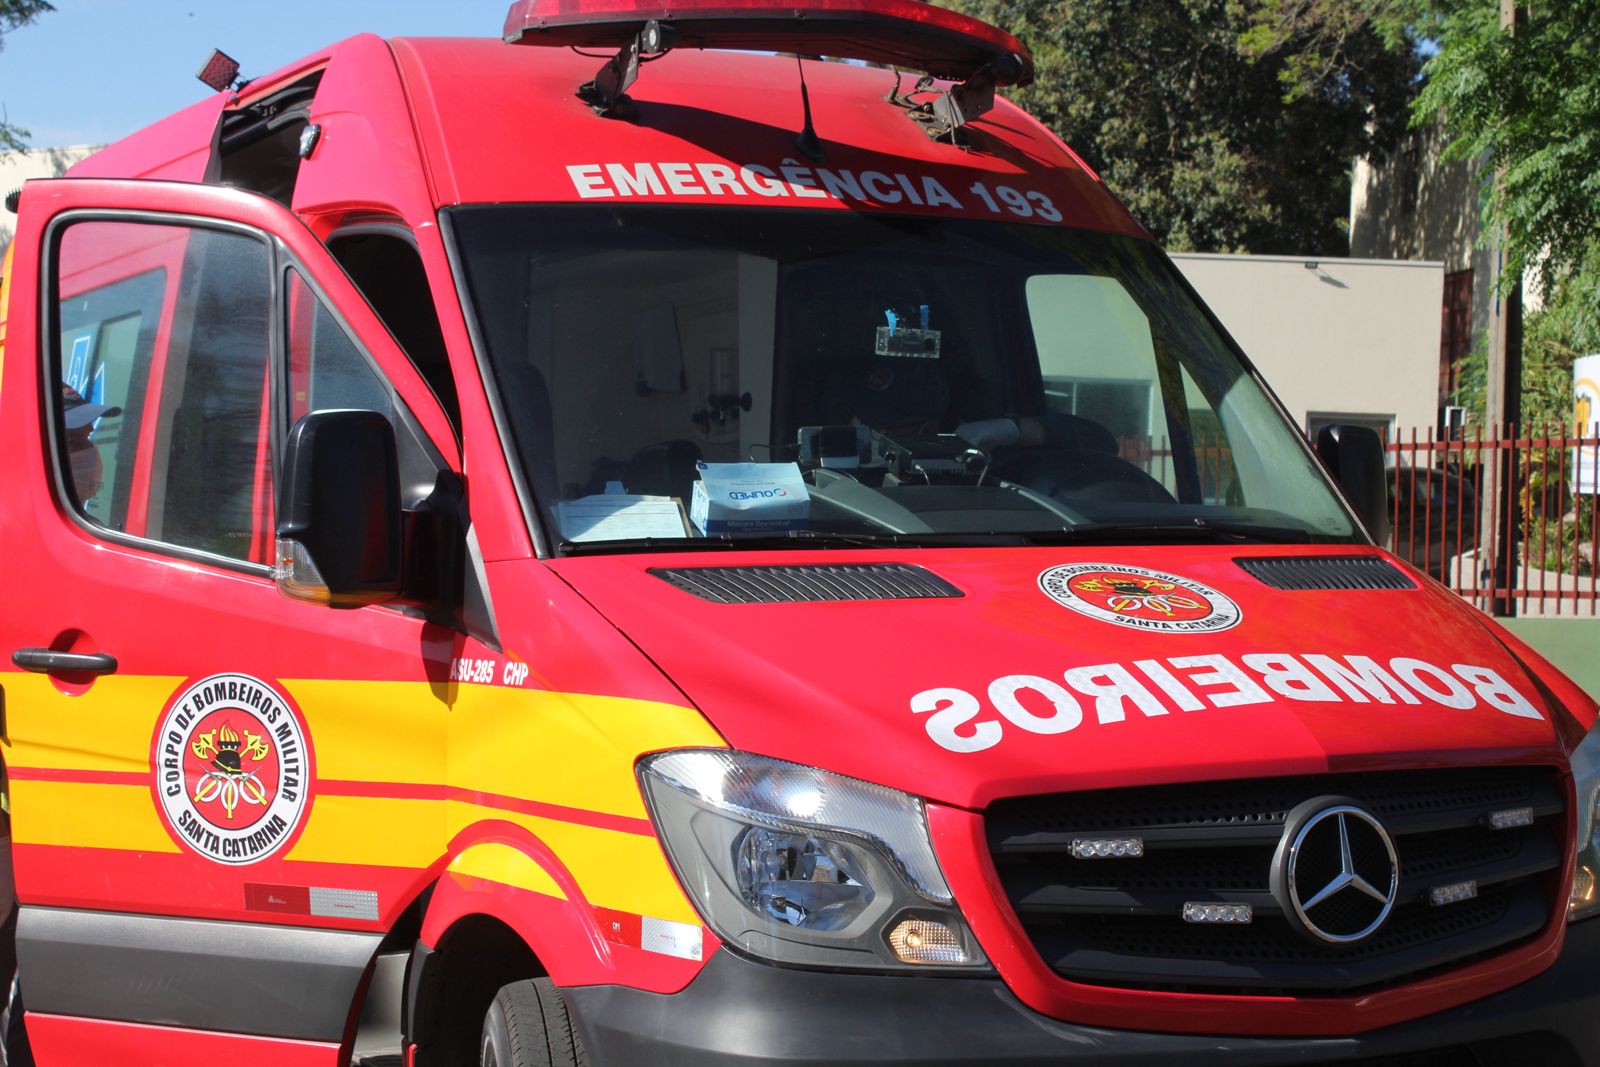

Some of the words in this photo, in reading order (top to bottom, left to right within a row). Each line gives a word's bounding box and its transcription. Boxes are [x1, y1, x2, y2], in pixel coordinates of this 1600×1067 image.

[566, 158, 963, 209] EMERGÊNCIA
[971, 183, 1064, 223] 193
[728, 490, 773, 500] OLIMED
[1047, 578, 1071, 598] CORPO
[1062, 565, 1149, 576] BOMBEIROS
[1155, 574, 1214, 595] MILITAR
[1114, 615, 1173, 629] SANTA
[1175, 613, 1231, 629] CATARINA
[449, 658, 495, 683] ASU-285
[503, 661, 529, 685] CHP
[164, 730, 182, 797] CORPO
[175, 703, 195, 731] DE
[192, 681, 281, 725] BOMBEIROS
[275, 721, 299, 803] MILITAR
[178, 809, 219, 855] SANTA
[223, 814, 288, 857] CATARINA
